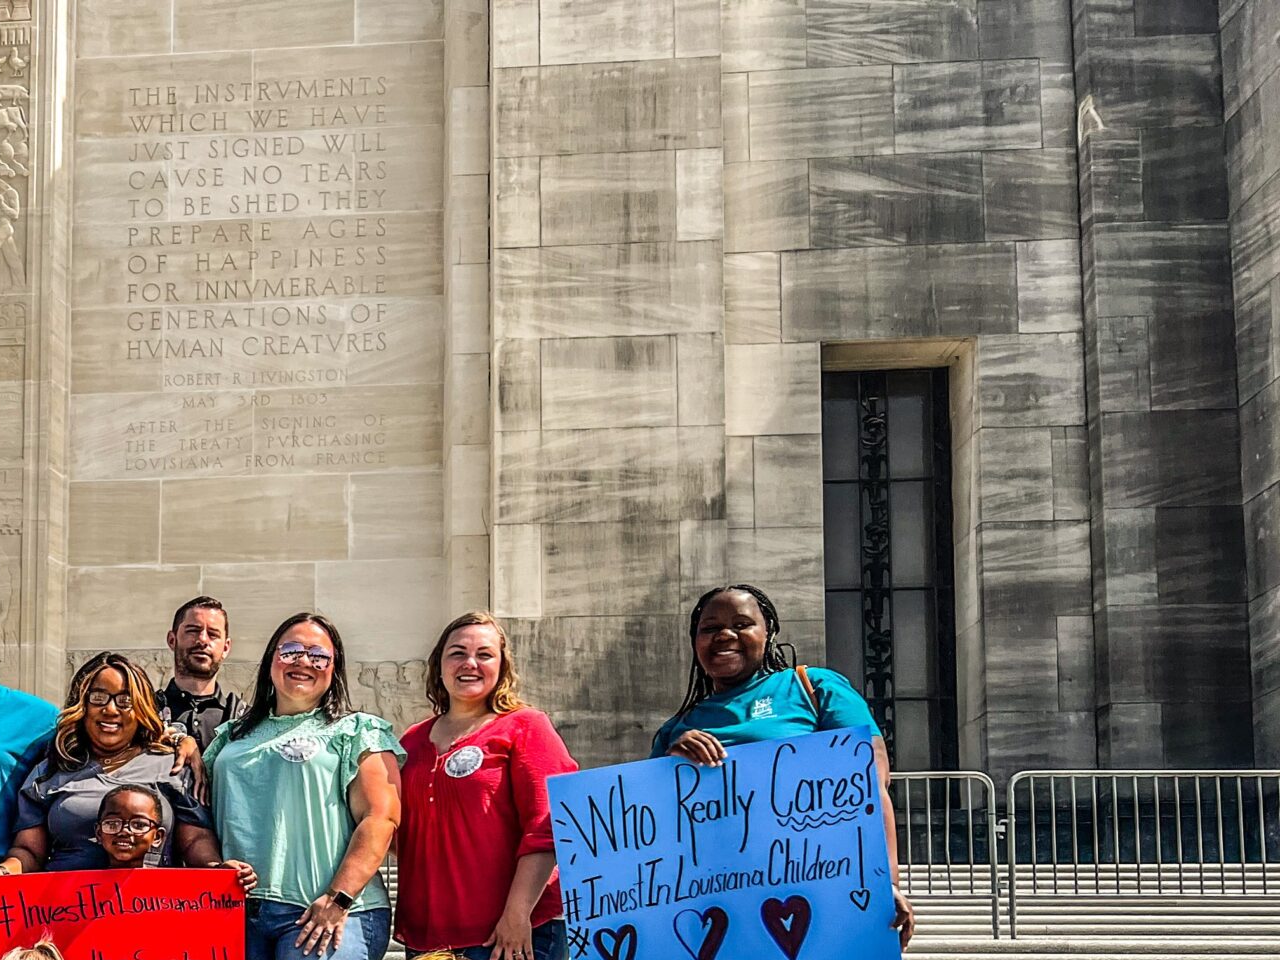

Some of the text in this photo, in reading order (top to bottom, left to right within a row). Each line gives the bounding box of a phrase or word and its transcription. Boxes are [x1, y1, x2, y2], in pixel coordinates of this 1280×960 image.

[129, 76, 387, 106] THE INSTRVMENTS
[129, 104, 386, 134] WHICH WE HAVE
[128, 132, 386, 163] JVST SIGNED WILL
[128, 161, 387, 191] CAVSE NO TEARS
[128, 189, 387, 218] TO BE SHED THEY
[127, 218, 387, 246] PREPARE AGES
[127, 246, 387, 274] OF HAPPINESS
[127, 274, 386, 303] FOR INNVMERABLE
[127, 303, 387, 331] GENERATIONS OF
[127, 331, 387, 359] HVMAN CREATVRES
[163, 372, 222, 387] ROBERT
[182, 395, 217, 409] MAY
[126, 414, 387, 434] AFTER THE SIGNING OF
[126, 433, 386, 453] THE TREATY PVRCHASING
[125, 451, 386, 471] LOVISIANA FROM FRANCE
[560, 741, 875, 866] Who Really Cares?
